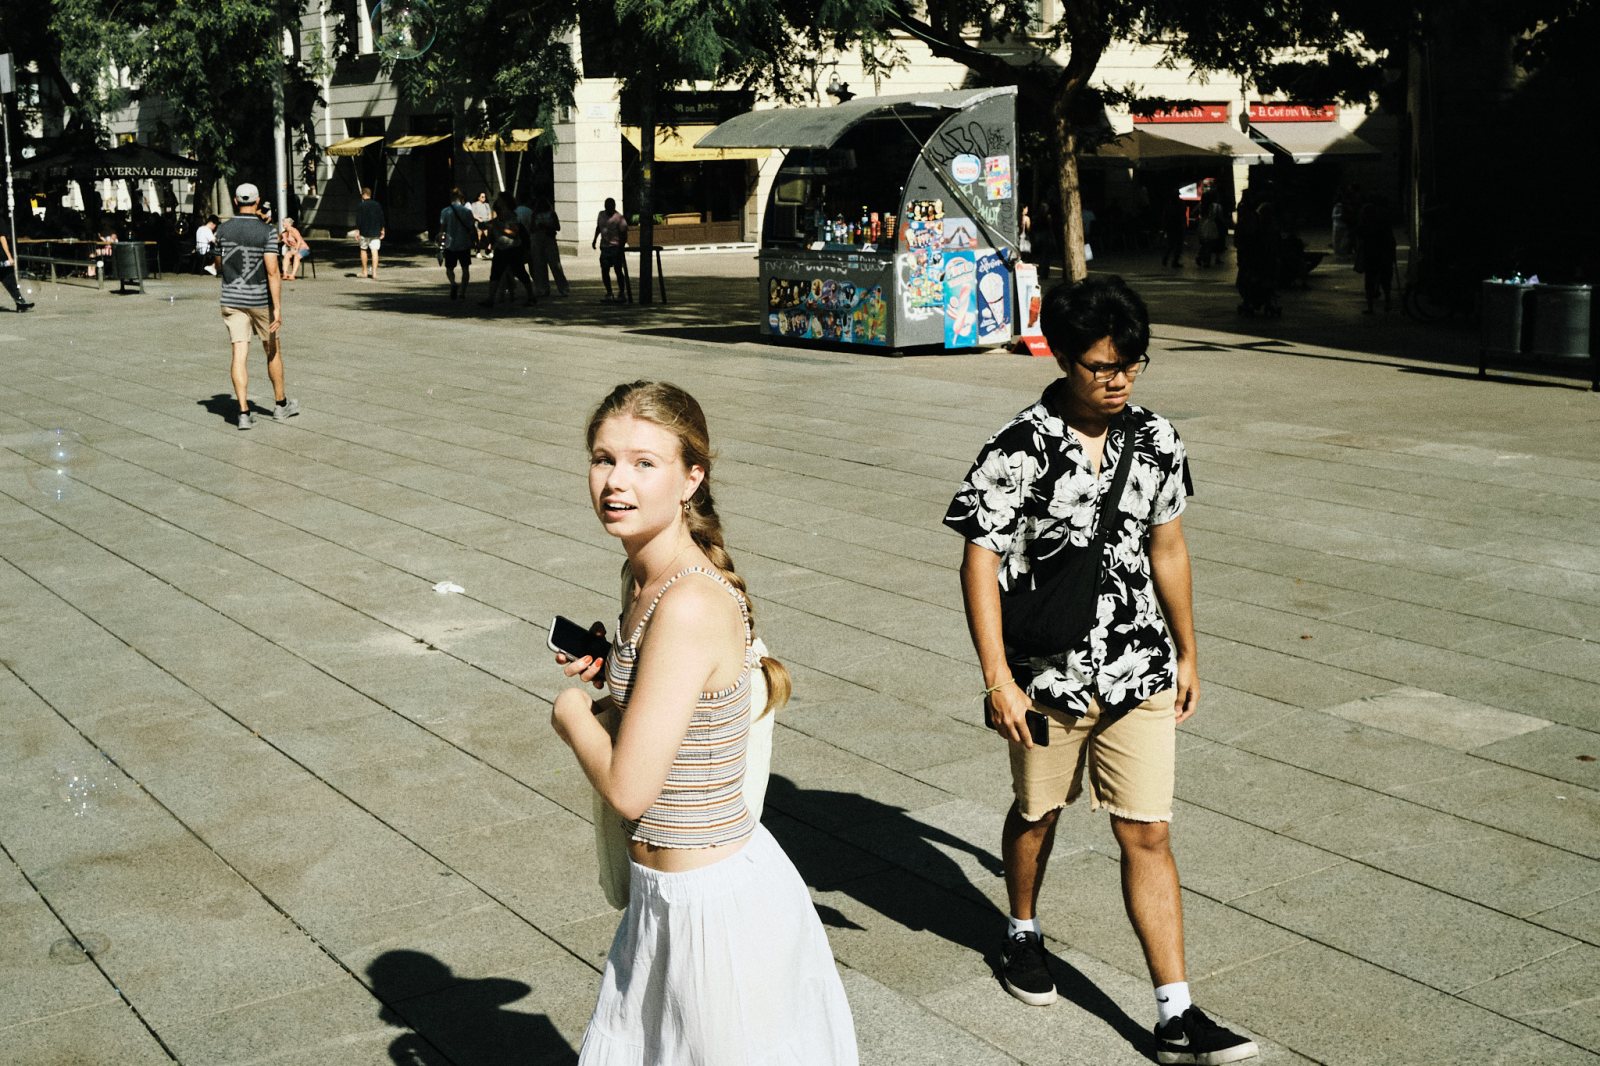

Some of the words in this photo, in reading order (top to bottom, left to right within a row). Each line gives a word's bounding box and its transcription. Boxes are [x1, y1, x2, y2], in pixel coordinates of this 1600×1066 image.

[94, 166, 148, 177] TAVERNA
[150, 167, 164, 176] del
[165, 166, 199, 177] BISBE
